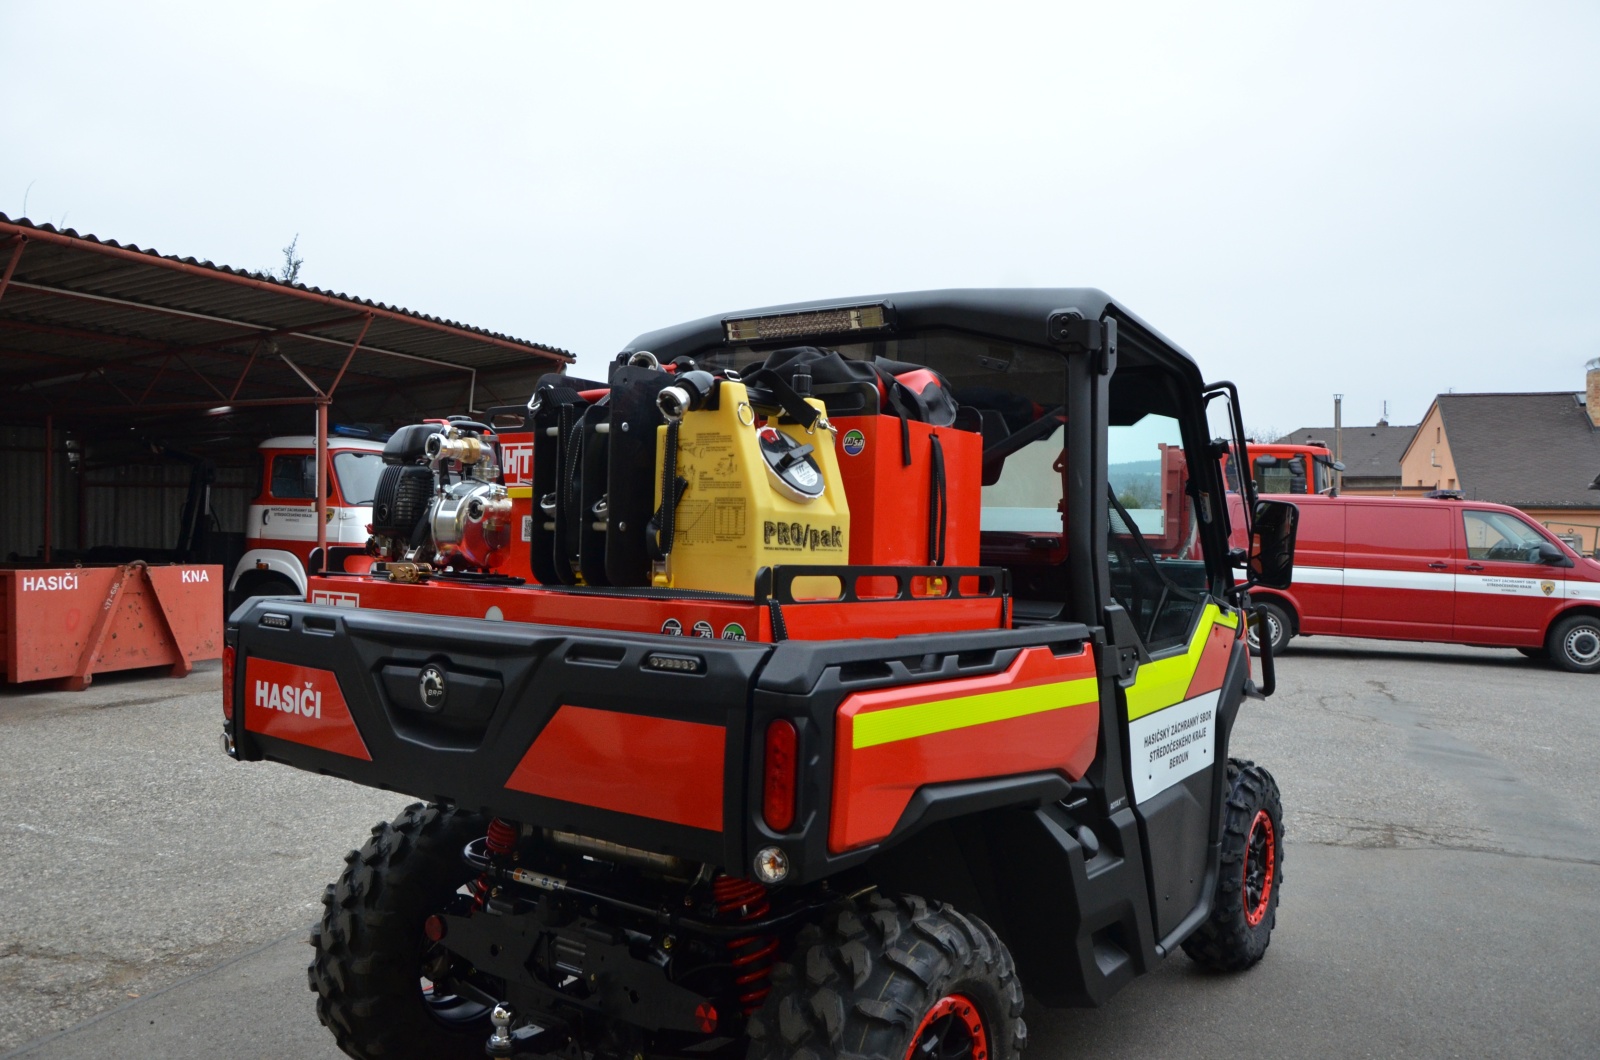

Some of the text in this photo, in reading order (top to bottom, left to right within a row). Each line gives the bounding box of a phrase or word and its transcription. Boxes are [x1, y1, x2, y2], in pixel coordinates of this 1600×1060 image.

[22, 572, 79, 592] HASIČI
[181, 569, 209, 583] KNA
[255, 680, 322, 720] HASIČI
[1143, 710, 1212, 748] HASIČSKÝ ZÁCHRANNÝ SBOR
[1149, 727, 1207, 763] STŘEDOČESKÉHO KRAJE
[1169, 751, 1189, 769] BEROUN
